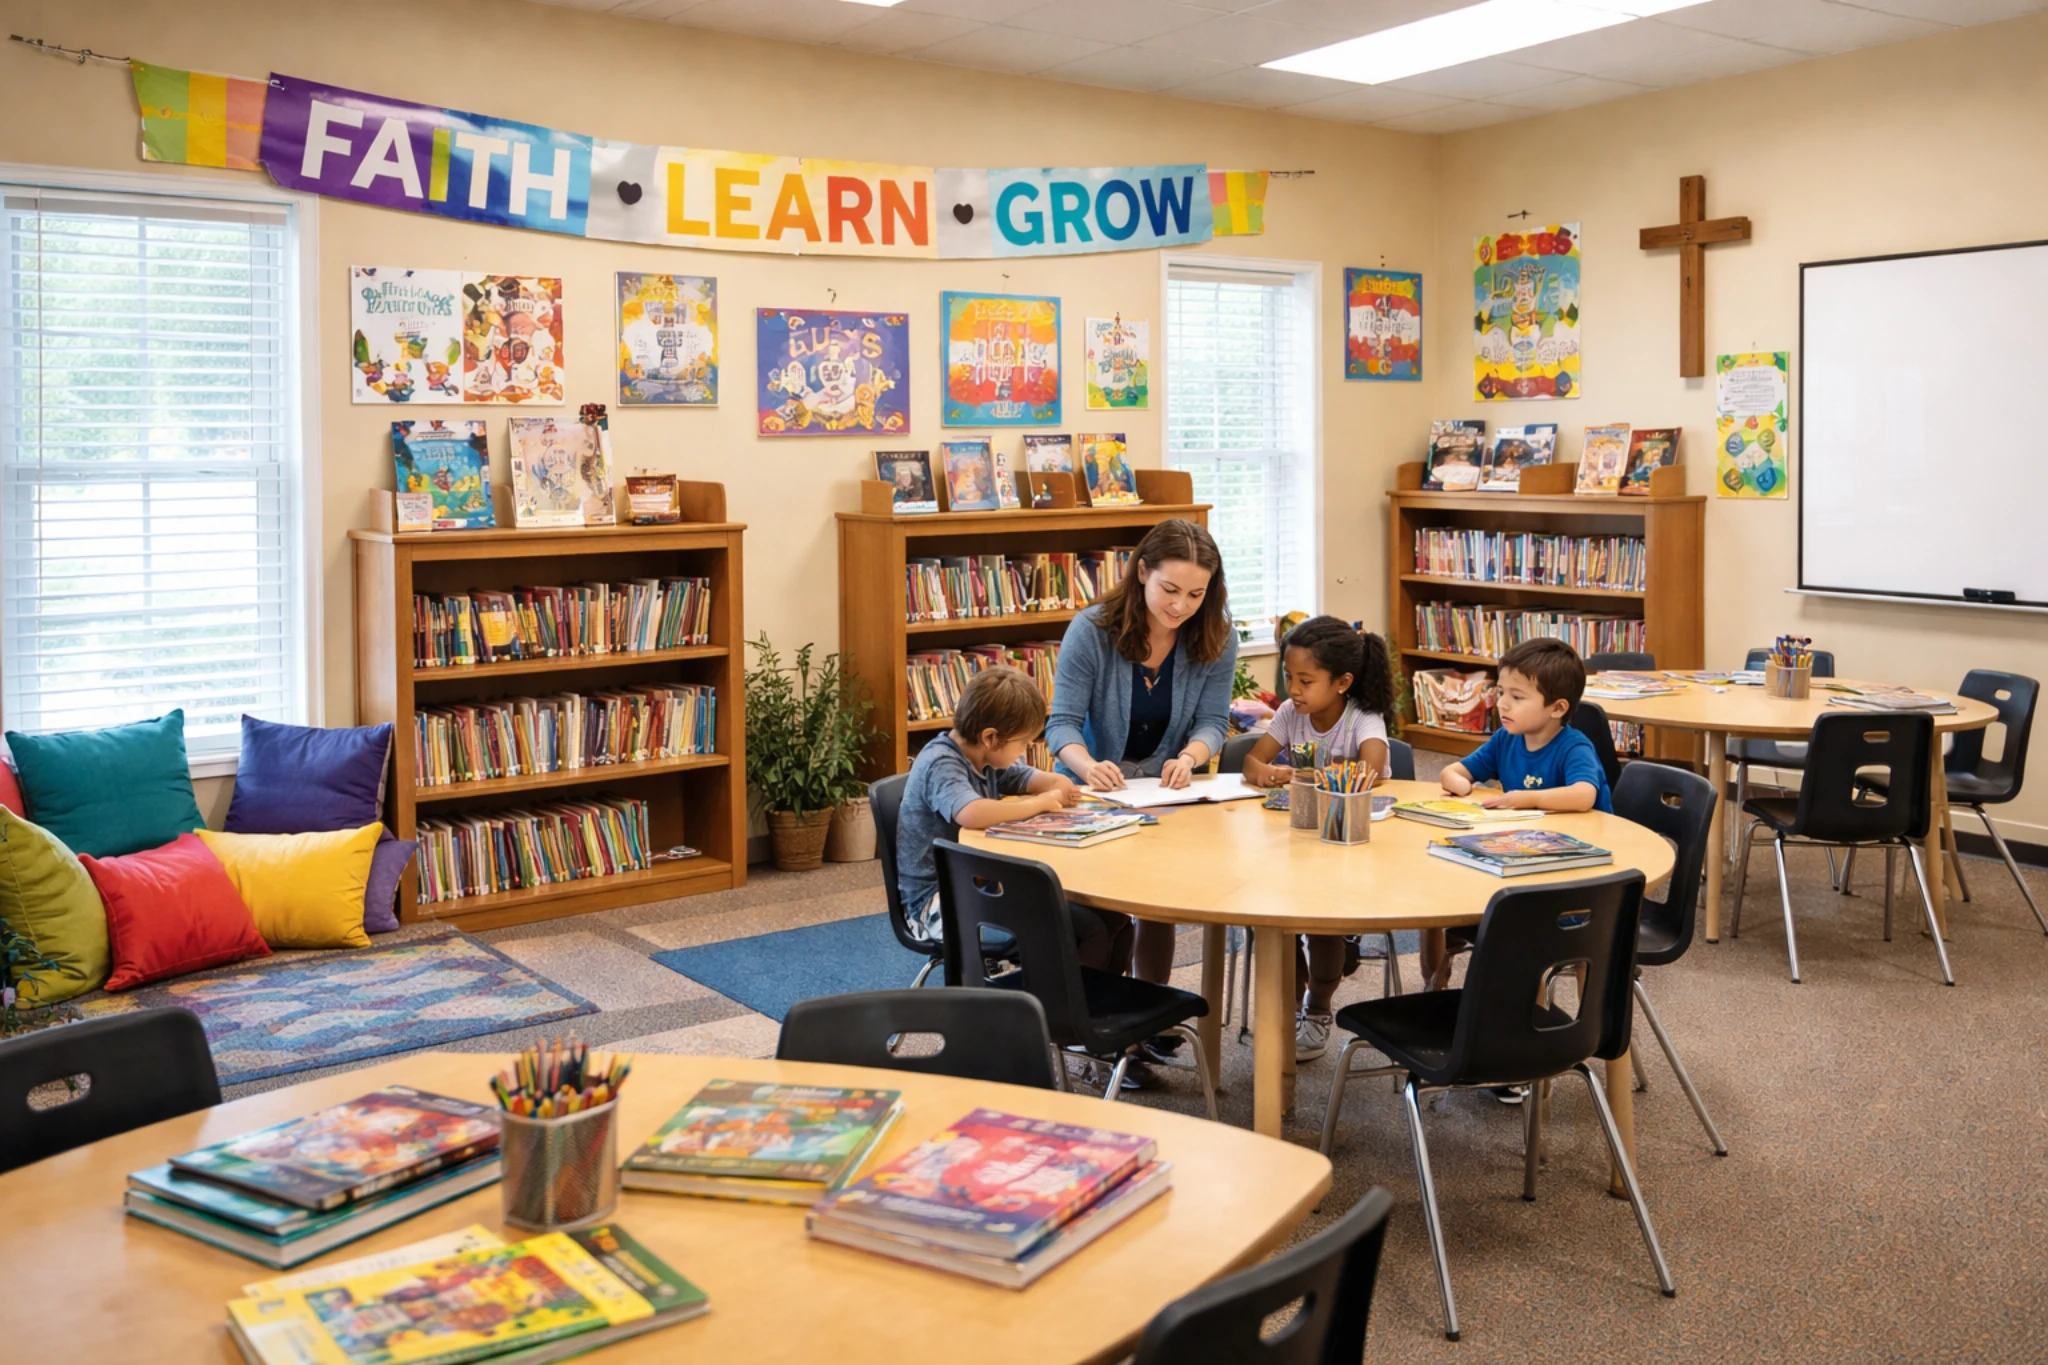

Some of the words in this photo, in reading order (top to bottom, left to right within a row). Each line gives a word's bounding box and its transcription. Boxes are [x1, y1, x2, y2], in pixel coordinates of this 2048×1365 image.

[300, 99, 571, 220] FAITH
[666, 162, 929, 246] LEARN
[996, 176, 1193, 246] GROW
